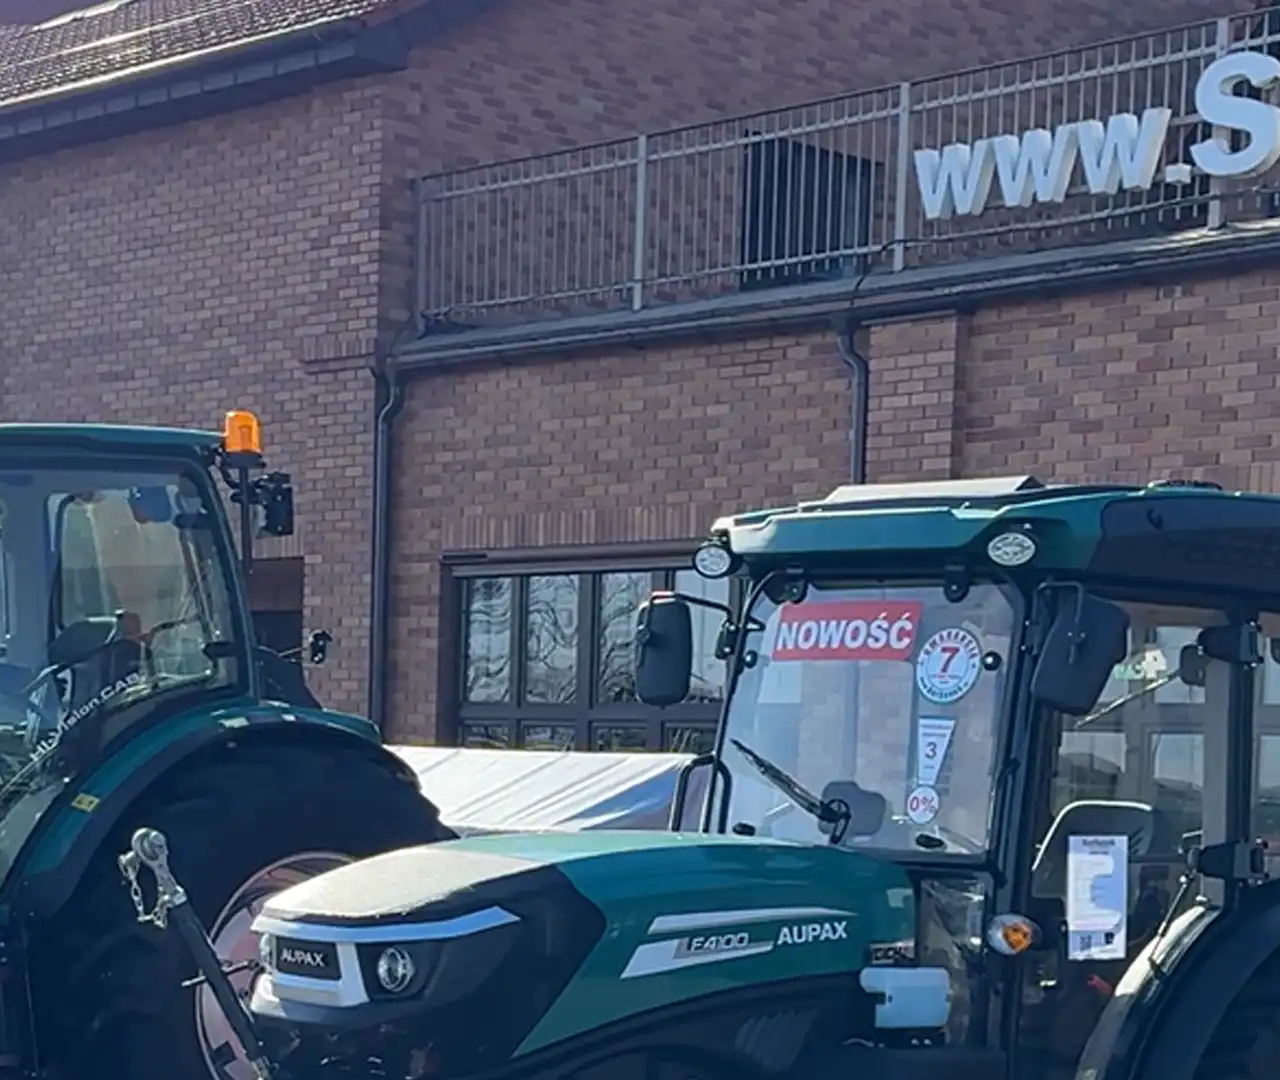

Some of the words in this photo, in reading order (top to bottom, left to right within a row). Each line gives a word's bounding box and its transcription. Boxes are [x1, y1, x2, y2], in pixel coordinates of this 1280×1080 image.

[776, 612, 913, 651] NOWOŚĆ
[941, 646, 960, 673] 7
[925, 741, 937, 760] 3
[910, 796, 937, 813] 0%
[776, 921, 848, 946] AUPAX
[280, 947, 326, 967] AUPAX
